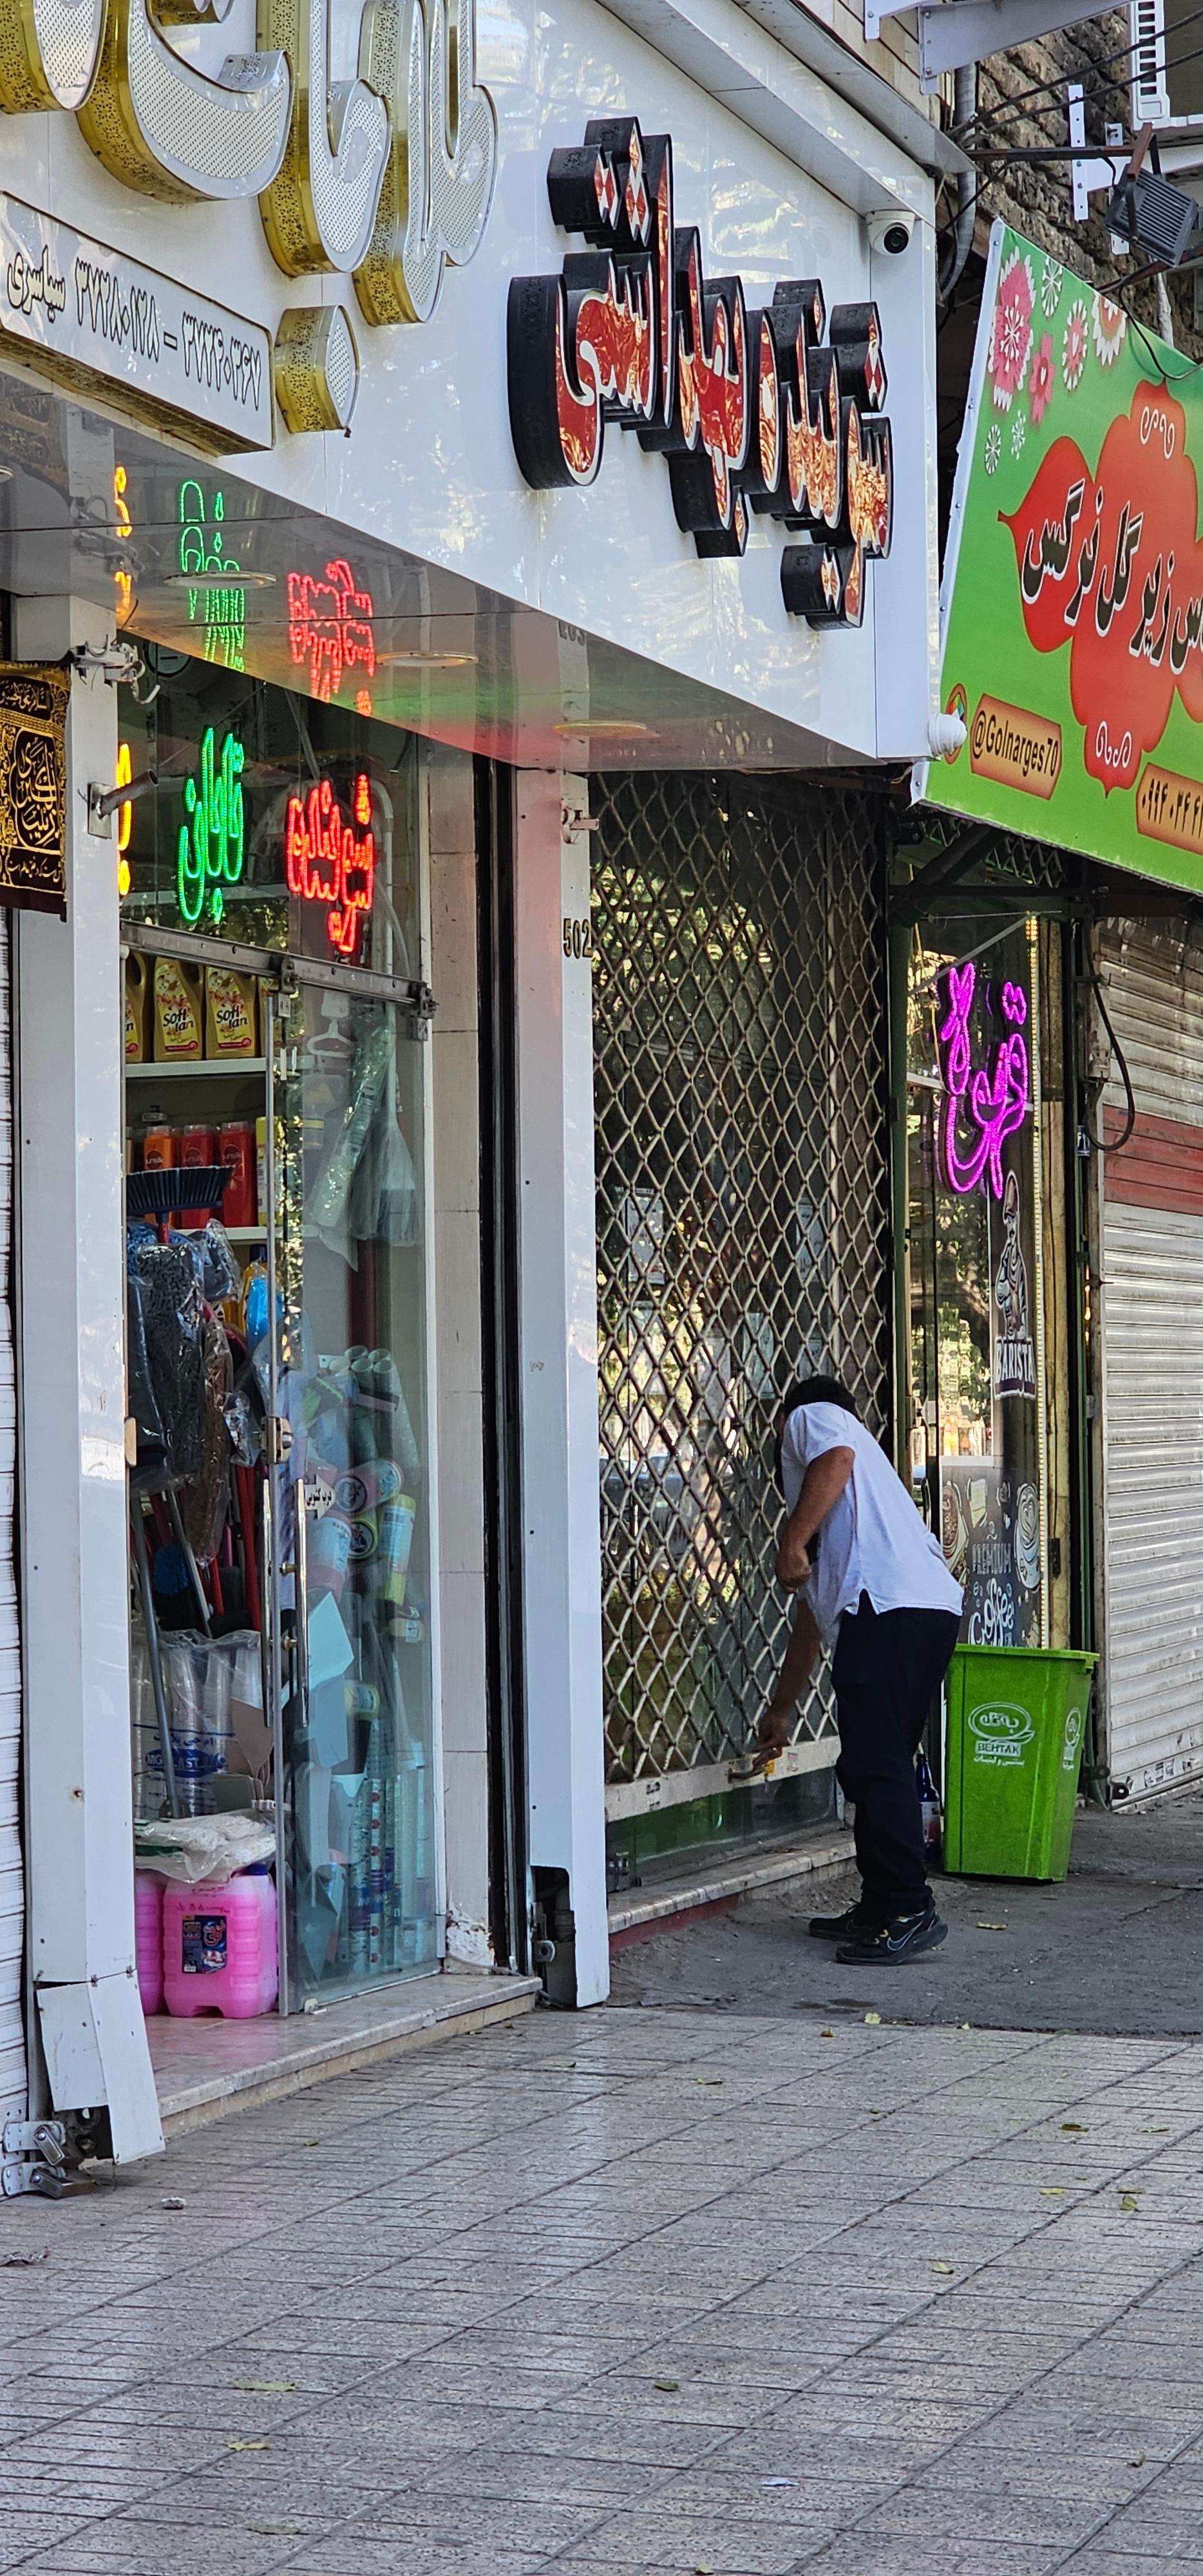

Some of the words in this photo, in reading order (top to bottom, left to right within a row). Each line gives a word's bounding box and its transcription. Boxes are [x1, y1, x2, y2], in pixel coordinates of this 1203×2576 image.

[1021, 477, 1103, 628] نرگس
[1095, 499, 1144, 638] گل
[1129, 549, 1175, 668] زیر
[972, 710, 1060, 778] @Golnarges70
[177, 725, 245, 925] تابان
[286, 772, 375, 954] شوینده
[563, 918, 593, 960] 502
[163, 1006, 188, 1027] Soft
[216, 1003, 240, 1025] Soft
[995, 1342, 1036, 1385] BARISTA
[972, 1542, 1012, 1575] PREMIUM
[978, 1742, 1019, 1755] BEHTAK
